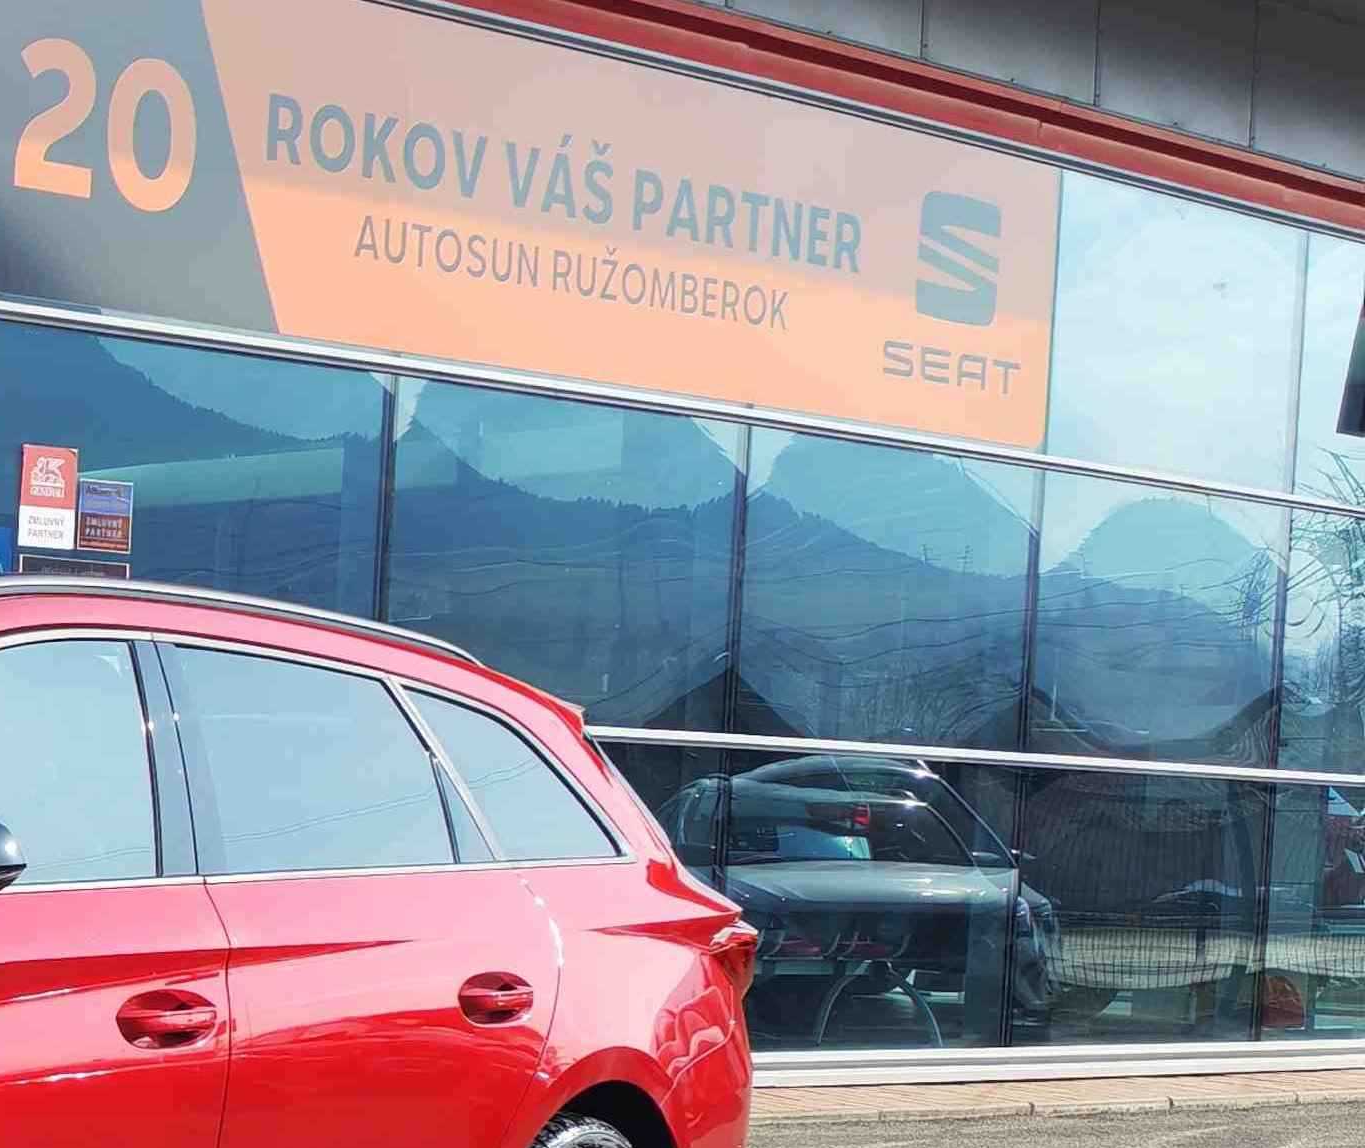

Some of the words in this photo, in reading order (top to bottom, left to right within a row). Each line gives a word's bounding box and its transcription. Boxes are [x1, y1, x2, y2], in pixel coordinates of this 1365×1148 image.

[14, 37, 197, 212] 20
[266, 93, 489, 200] ROKOV
[506, 134, 615, 225] VÁŠ
[632, 168, 862, 274] PARTNER
[354, 215, 540, 289] AUTOSUN
[551, 246, 789, 331] RUŽOMBEROK
[883, 339, 1021, 395] SEAT
